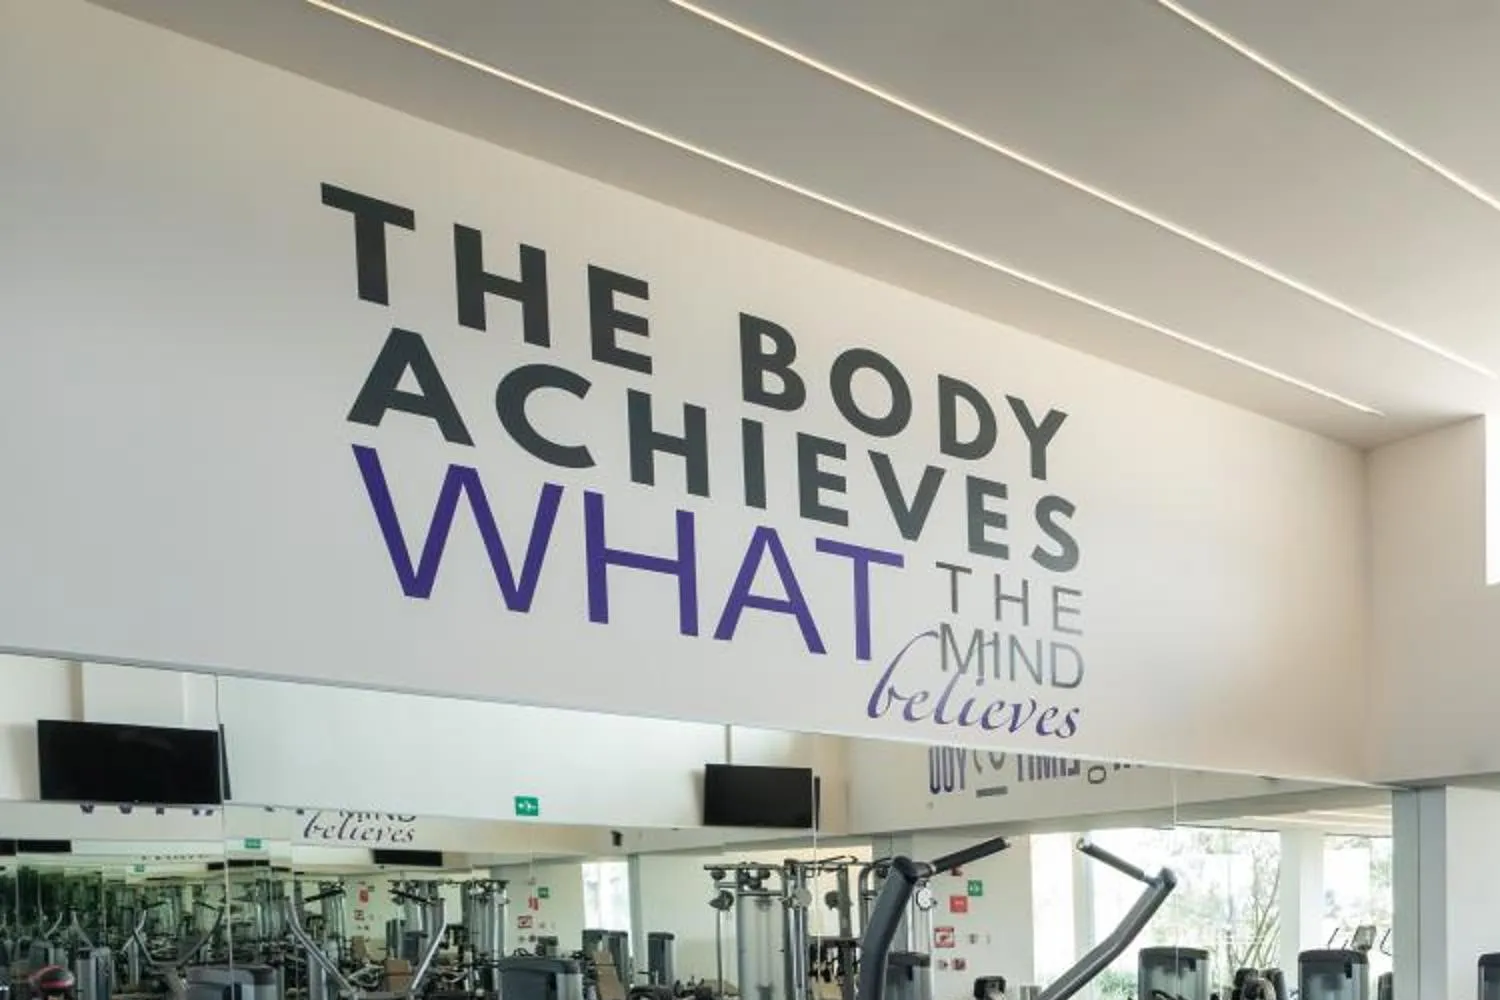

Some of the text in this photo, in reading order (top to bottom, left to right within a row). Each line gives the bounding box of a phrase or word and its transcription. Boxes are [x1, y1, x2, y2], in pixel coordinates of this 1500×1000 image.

[320, 181, 1069, 482] THE BODY
[346, 326, 1080, 573] ACHIEVES
[352, 443, 905, 662] WHAT
[936, 560, 1083, 636] THE
[866, 630, 1081, 740] believes
[940, 622, 1084, 690] MIND
